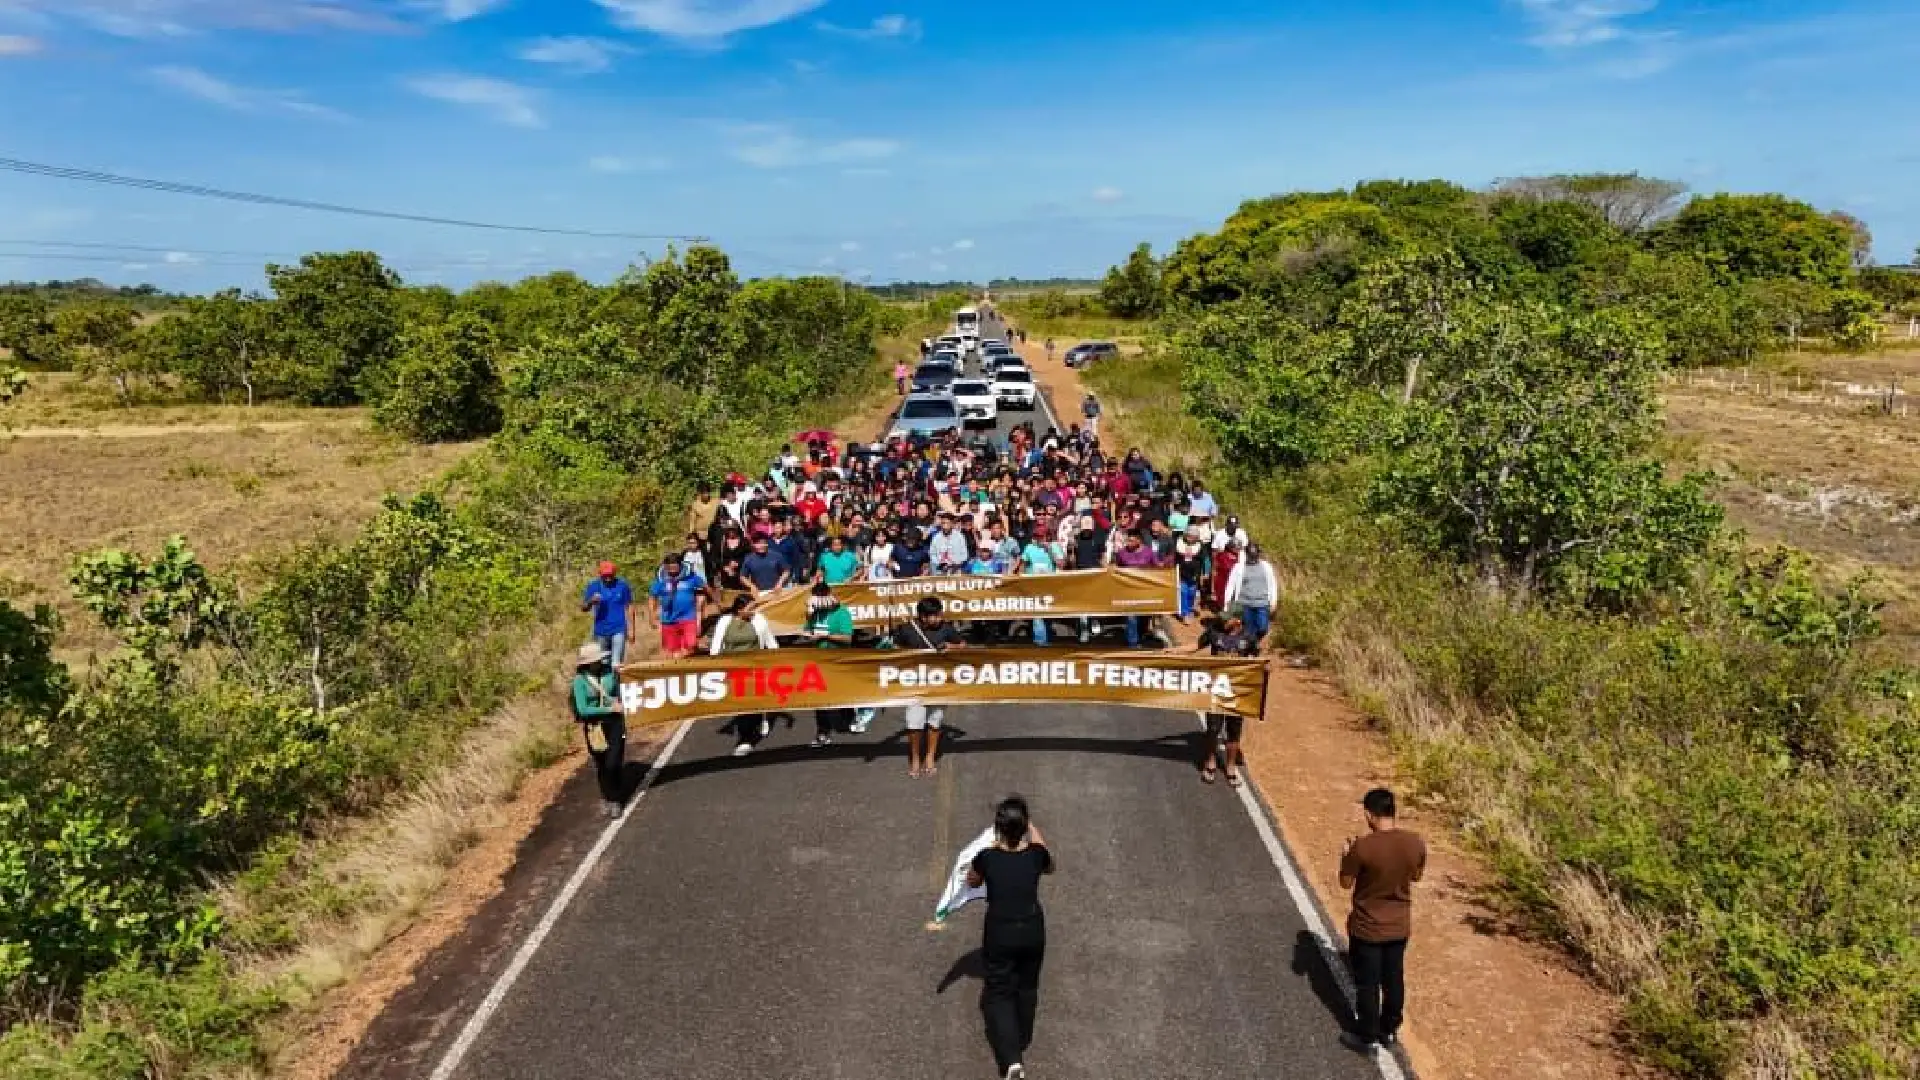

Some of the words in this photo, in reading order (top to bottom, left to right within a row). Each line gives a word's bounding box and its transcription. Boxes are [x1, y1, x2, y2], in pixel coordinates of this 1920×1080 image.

[879, 601, 945, 619] MAT
[951, 600, 963, 613] O
[969, 596, 1054, 612] GABRIEL?
[620, 662, 827, 713] #JUSTIÇA
[879, 664, 948, 688] Pelo
[953, 661, 1081, 685] GABRIEL
[1088, 663, 1235, 698] FERREIRA
